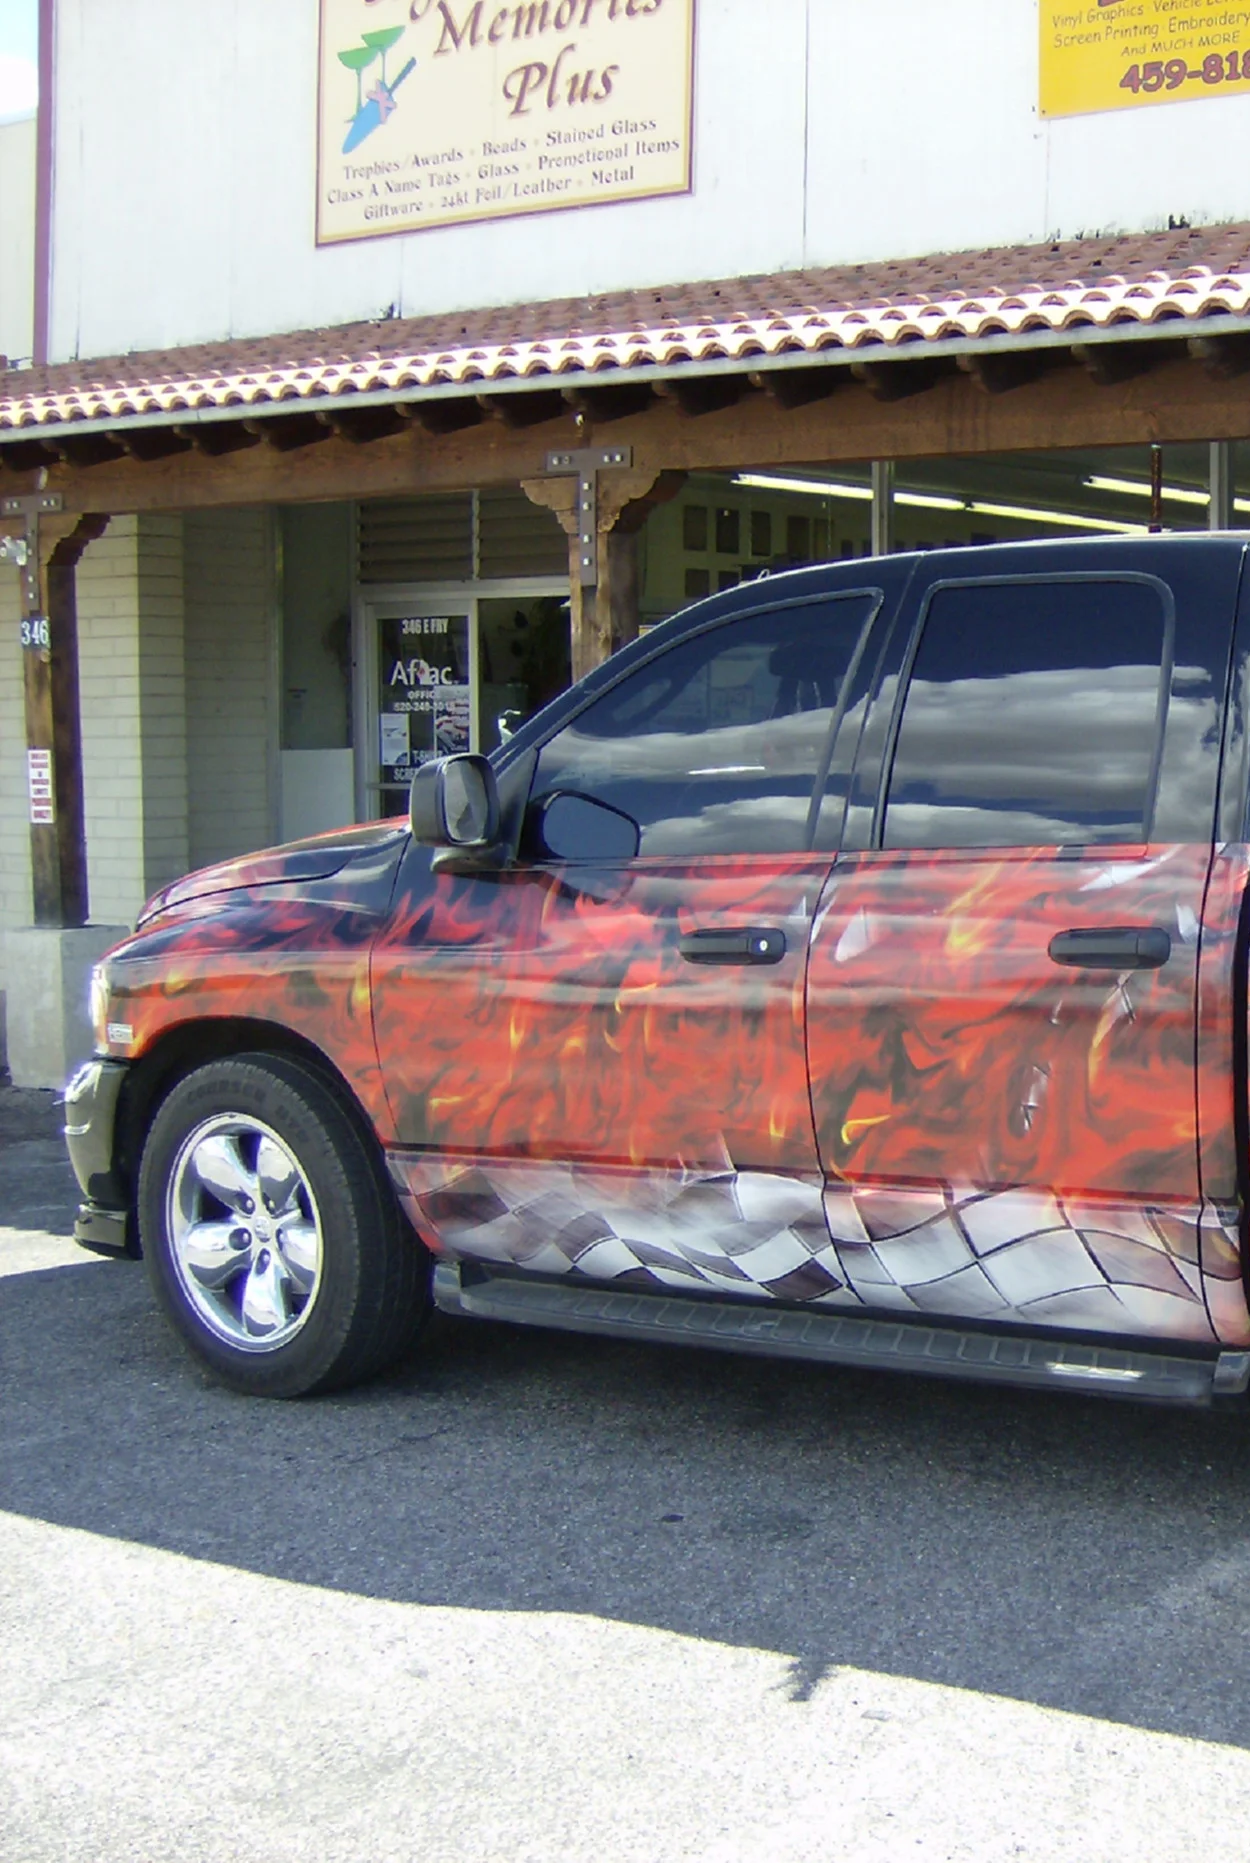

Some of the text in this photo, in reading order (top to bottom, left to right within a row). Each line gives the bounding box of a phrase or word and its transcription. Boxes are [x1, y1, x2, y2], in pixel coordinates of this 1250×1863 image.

[1052, 10, 1083, 30] Vinyl
[1087, 5, 1144, 23] Graphics
[1054, 29, 1100, 48] Screen
[1105, 24, 1159, 41] Printing
[1121, 44, 1146, 57] And
[1151, 37, 1194, 53] MUCH
[502, 43, 620, 118] Plus
[343, 119, 656, 180] Trophies/Awards Beads Stained Glass
[327, 138, 680, 205] Class A Name Tags Glass Promotional Items
[364, 166, 634, 220] Giftware 24kt Foil/Leather Metal
[21, 619, 50, 646] 346
[390, 658, 453, 685] Aflac
[407, 690, 435, 699] OFFIC
